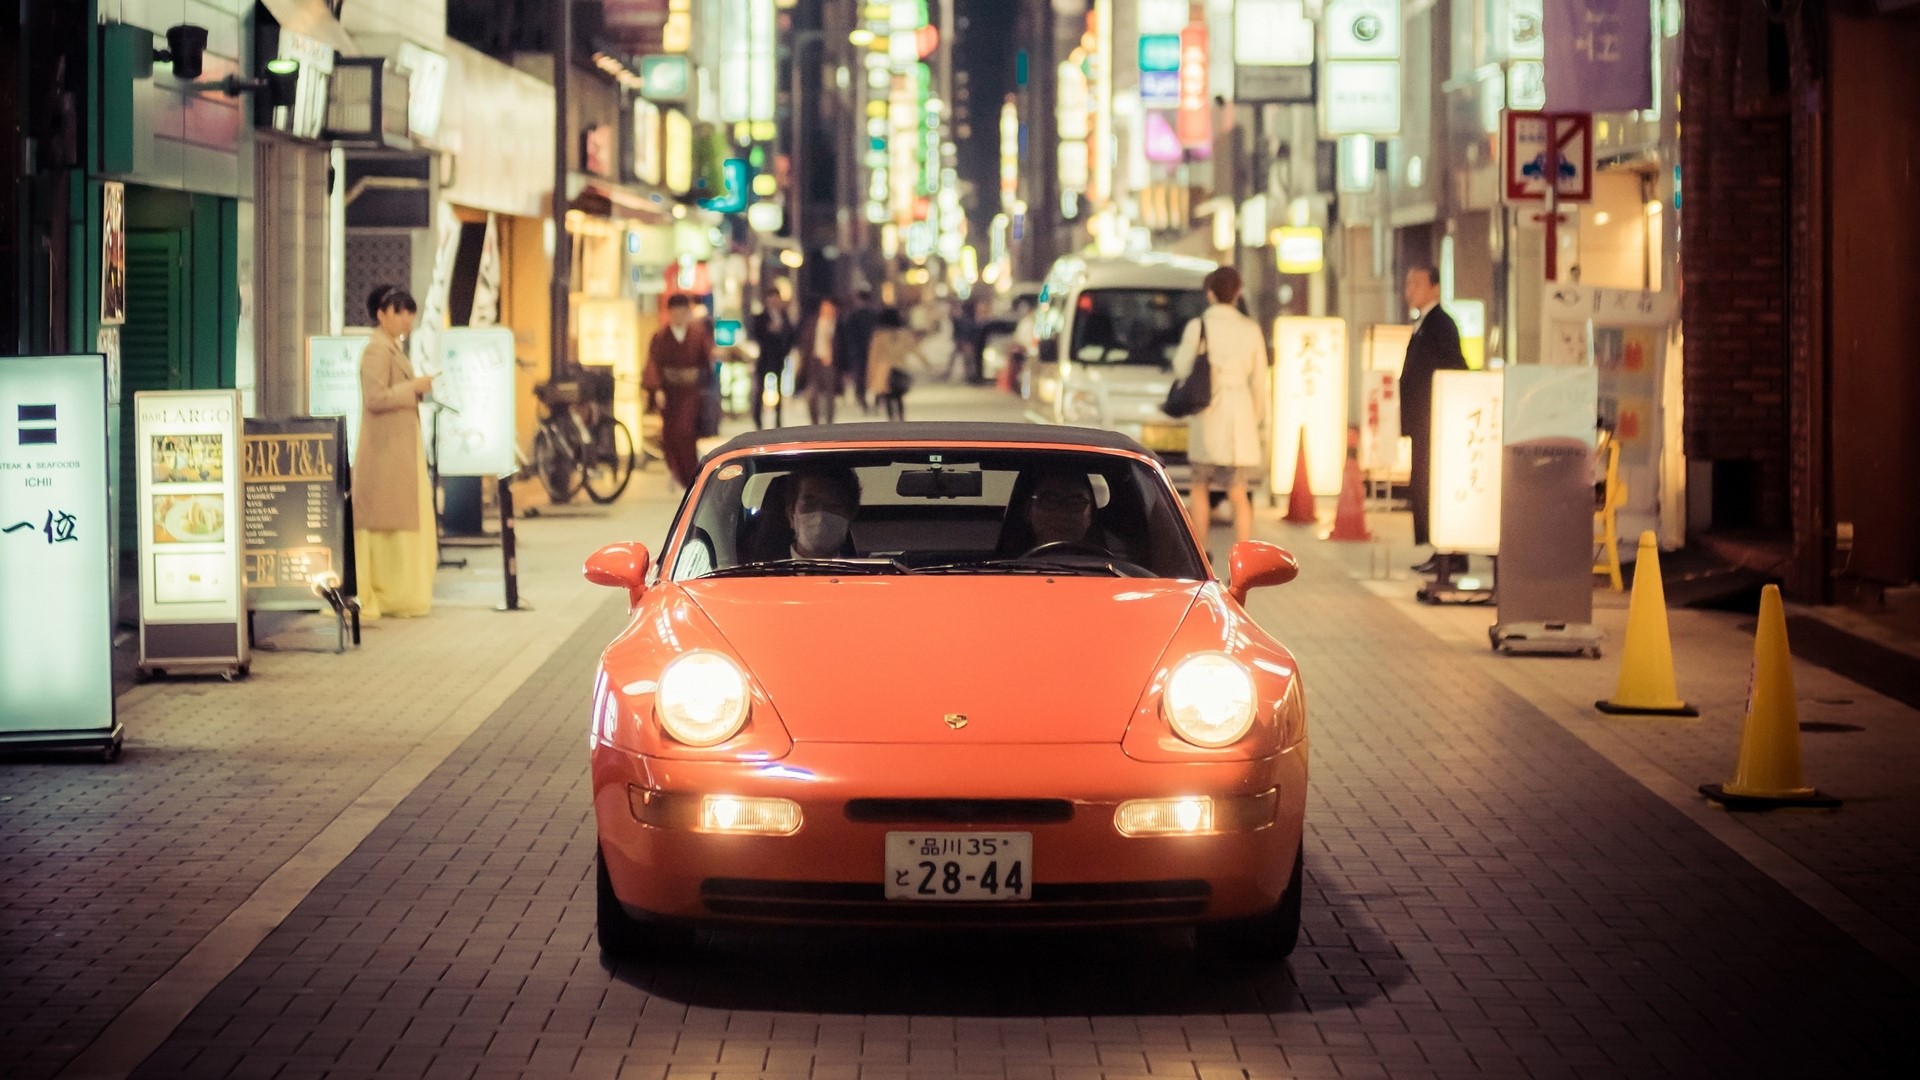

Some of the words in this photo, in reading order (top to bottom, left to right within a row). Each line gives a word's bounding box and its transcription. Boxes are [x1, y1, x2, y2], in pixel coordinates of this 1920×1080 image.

[163, 408, 230, 423] LARGO
[26, 462, 32, 470] &
[36, 460, 81, 470] SEAFOODS
[244, 440, 280, 476] BAR
[286, 440, 333, 476] T&A.
[25, 477, 52, 487] ICHII
[2, 509, 78, 544] 一位
[920, 838, 961, 856] 品川
[966, 838, 997, 856] 35
[895, 869, 910, 886] と
[917, 860, 1024, 895] 28-44
